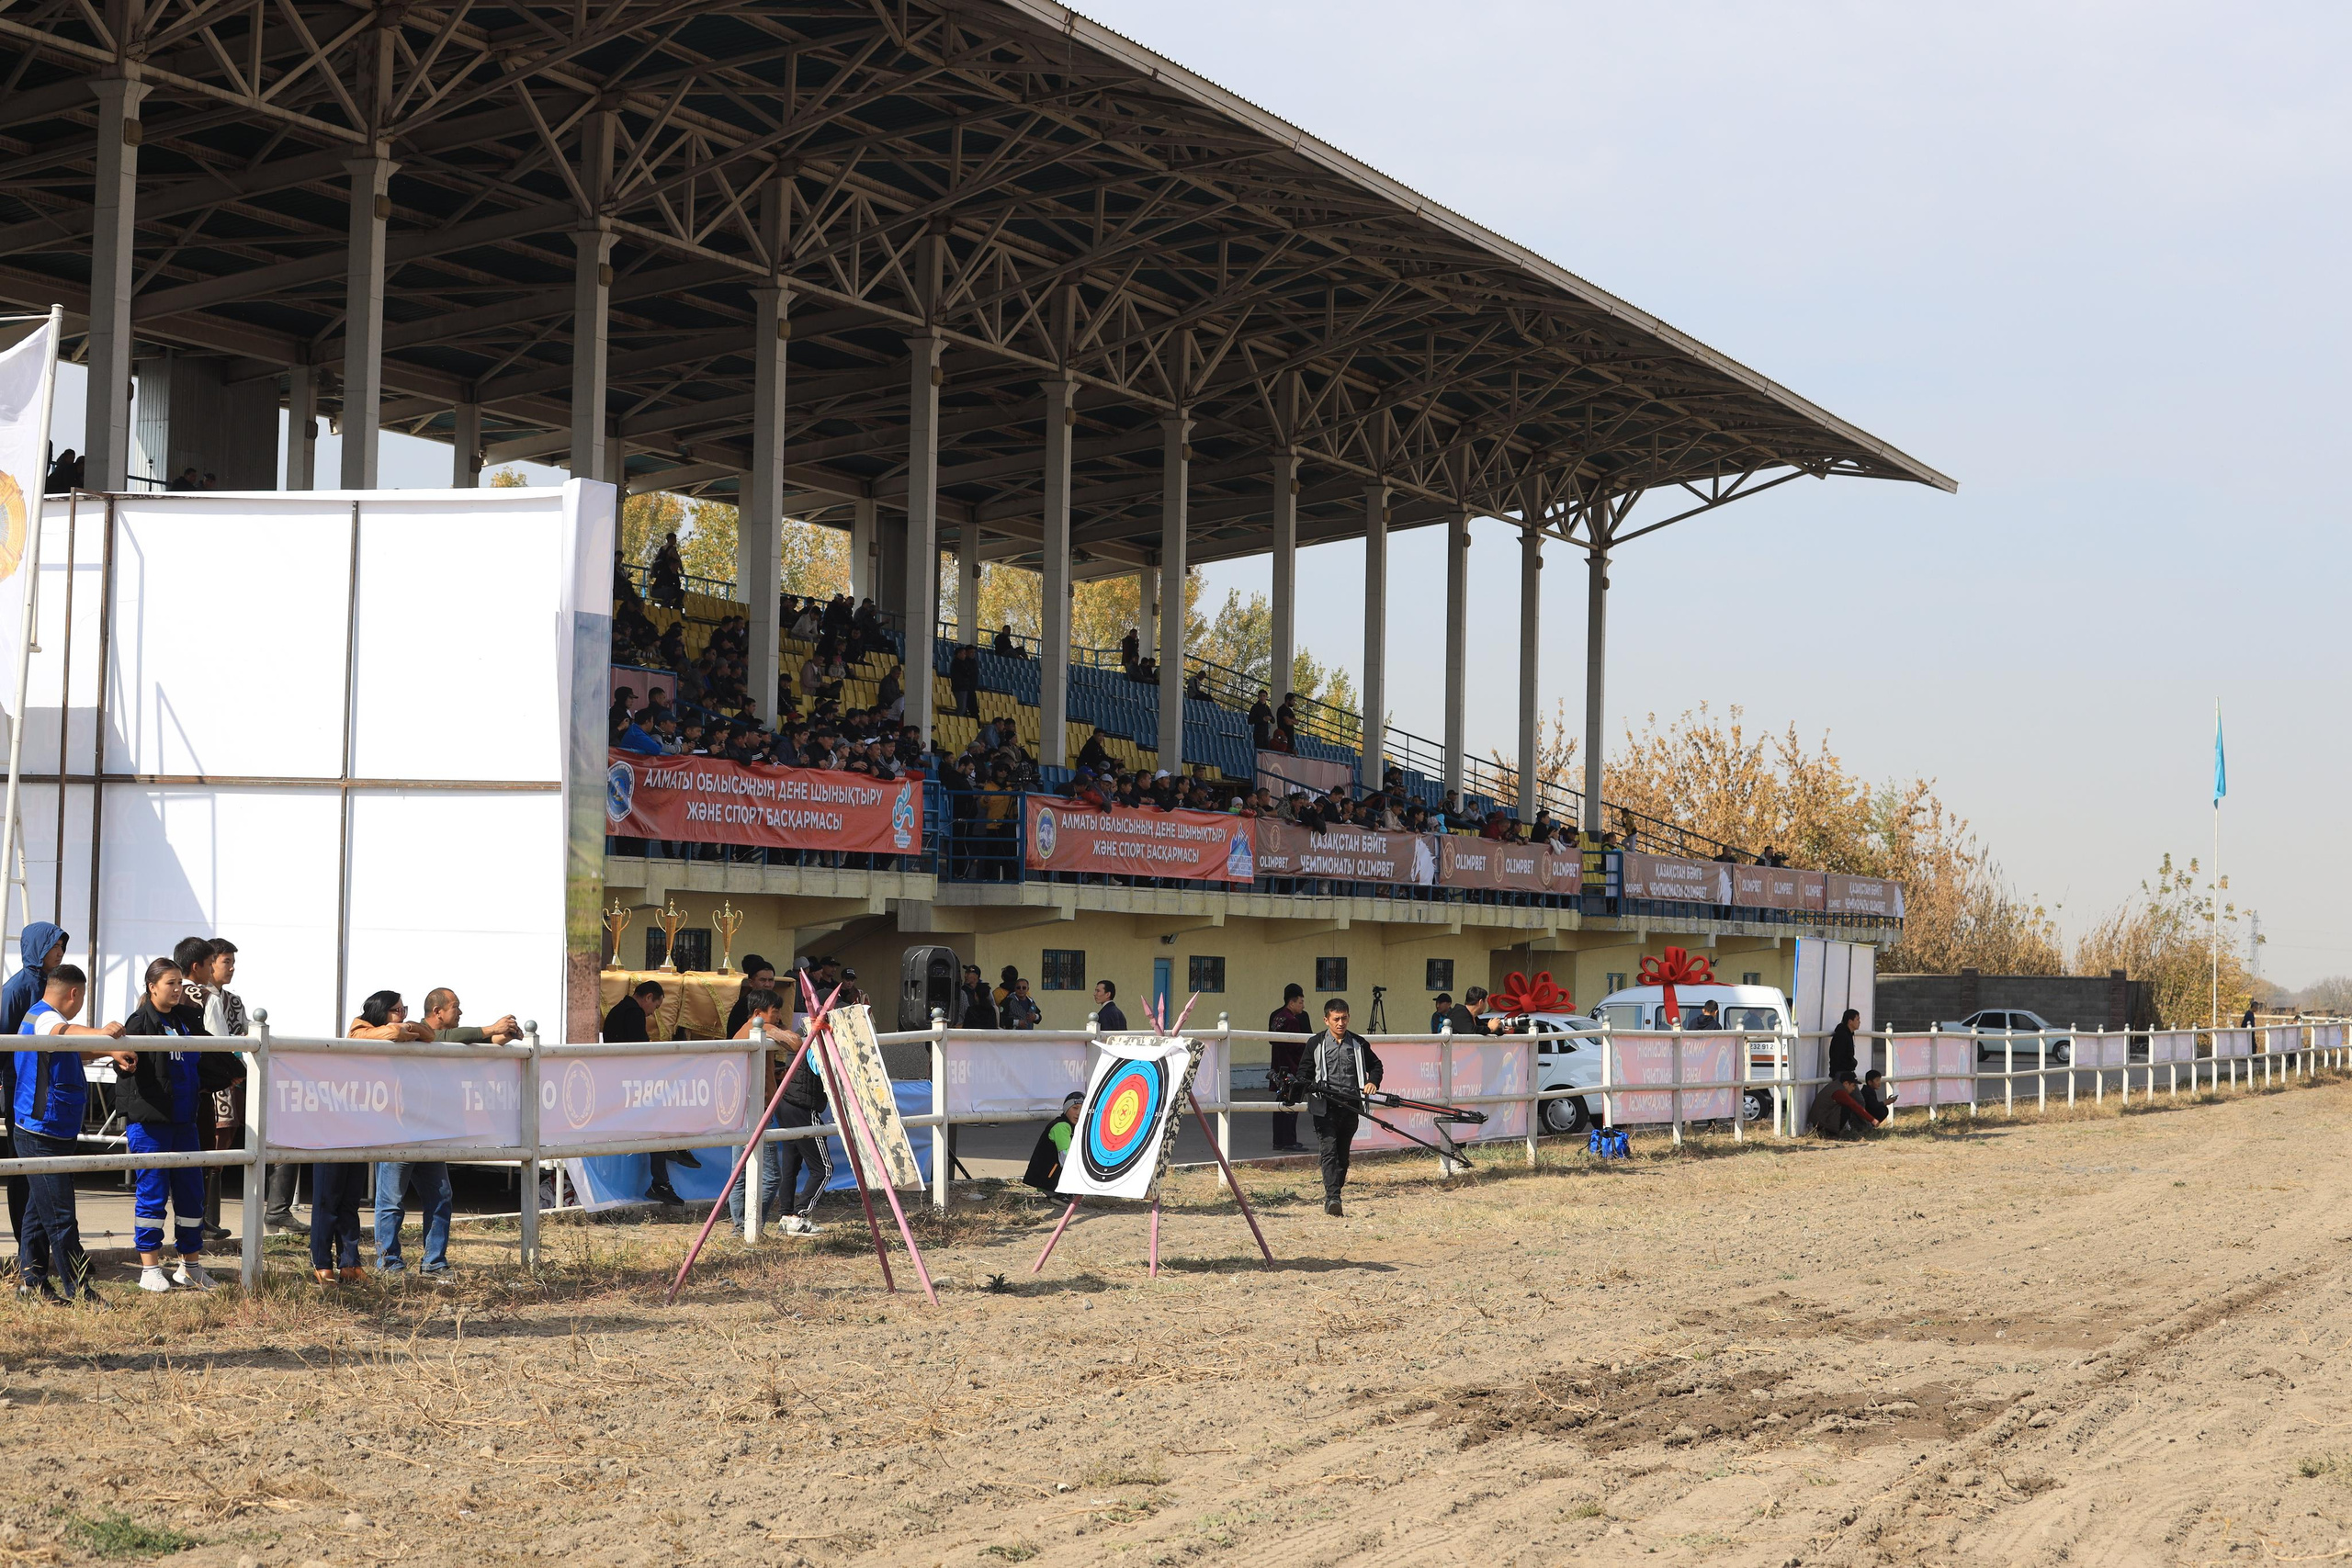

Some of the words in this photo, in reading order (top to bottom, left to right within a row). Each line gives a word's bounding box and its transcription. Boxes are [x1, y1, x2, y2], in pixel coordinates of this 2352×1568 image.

[643, 769, 693, 790] АЛМАТЫ
[696, 773, 775, 801] ОБЛЫСЫНЫҢ
[778, 781, 808, 802] ДЕНЕ
[810, 784, 883, 807] ШЫНЫҚТЫРУ
[686, 801, 722, 822] ЖӘНЕ
[725, 804, 763, 825] СПОРТ
[766, 807, 842, 830] БАСҚАРМАСЫ
[1061, 813, 1098, 830] АЛМАТЫ
[1100, 816, 1153, 839] ОБЛЫСЫНЫҢ
[1155, 821, 1176, 840] ДЕНЕ
[1177, 823, 1227, 844] ШЫНЫҚТЫРУ
[1092, 840, 1117, 857] ЖӘНЕ
[1119, 841, 1145, 859] СПОРТ
[1147, 844, 1199, 863] БАСҚАРМАСЫ
[1310, 831, 1360, 854] ҚАЗАҚСТАН
[1362, 832, 1386, 854] БӘЙГЕ
[1260, 856, 1289, 869] OLIMPBET
[1300, 855, 1355, 874] ЧЕМПИОНАТЫ
[1357, 858, 1395, 878] OLIMPBET
[1455, 853, 1487, 872] OLIMPBET
[1506, 857, 1534, 874] OLIMPBET
[1553, 862, 1579, 877] OLIMPBET
